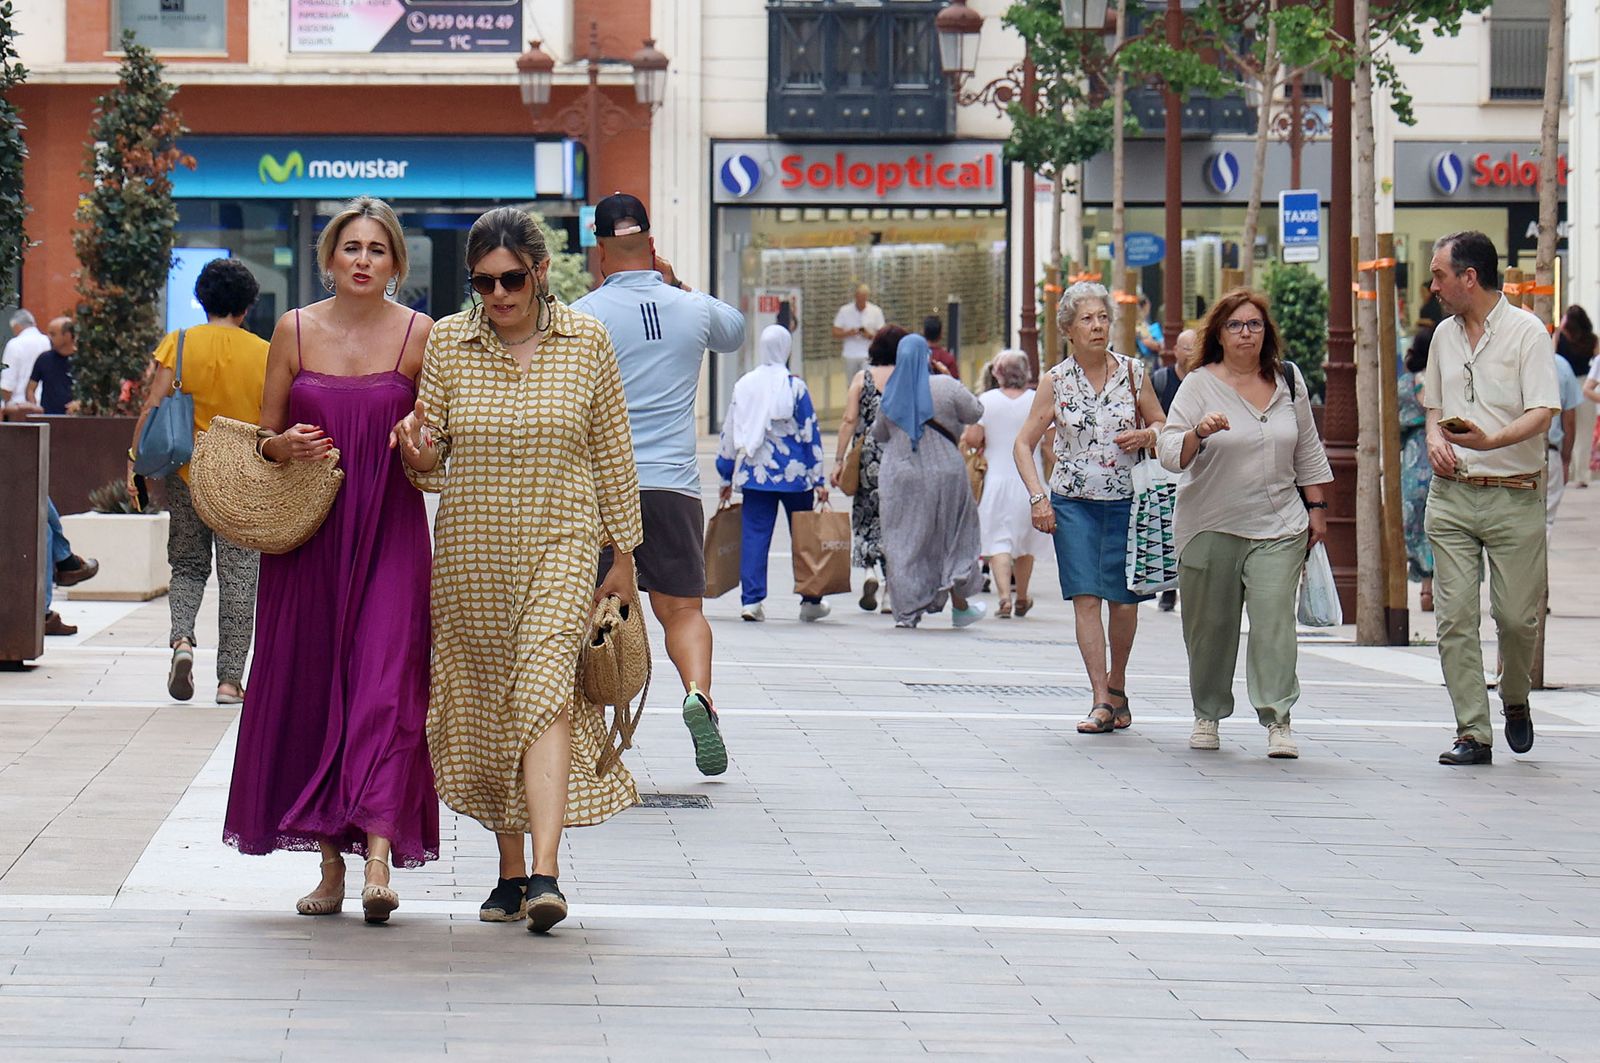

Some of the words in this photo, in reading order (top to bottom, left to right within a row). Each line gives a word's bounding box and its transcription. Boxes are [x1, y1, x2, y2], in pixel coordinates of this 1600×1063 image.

[428, 14, 454, 29] 959
[456, 14, 474, 29] 04
[476, 14, 494, 29] 42
[496, 14, 514, 29] 49
[308, 157, 409, 179] movistar
[780, 152, 995, 196] Soloptical
[1284, 208, 1319, 223] TAXIS
